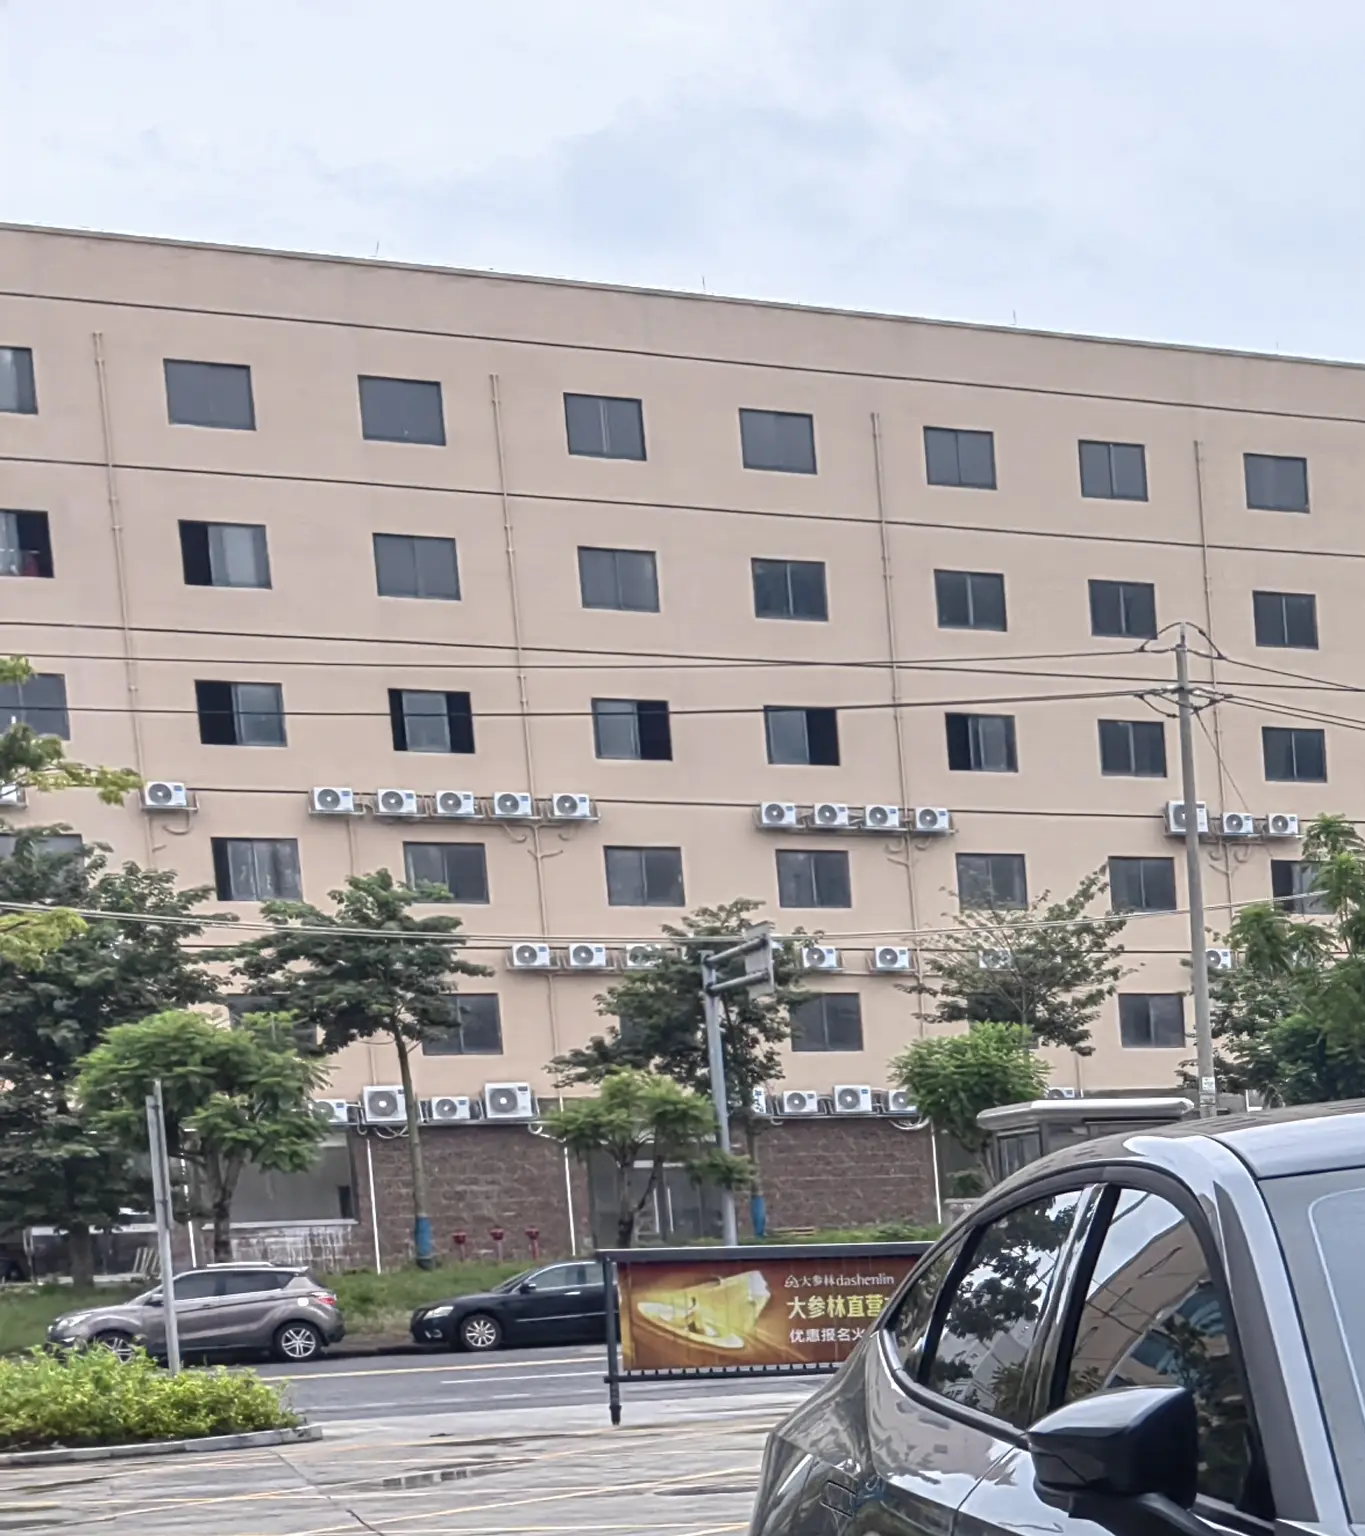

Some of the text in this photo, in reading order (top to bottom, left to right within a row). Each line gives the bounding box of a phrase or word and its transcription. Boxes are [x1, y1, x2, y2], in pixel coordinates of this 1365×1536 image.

[786, 1293, 891, 1319] 大参林直营
